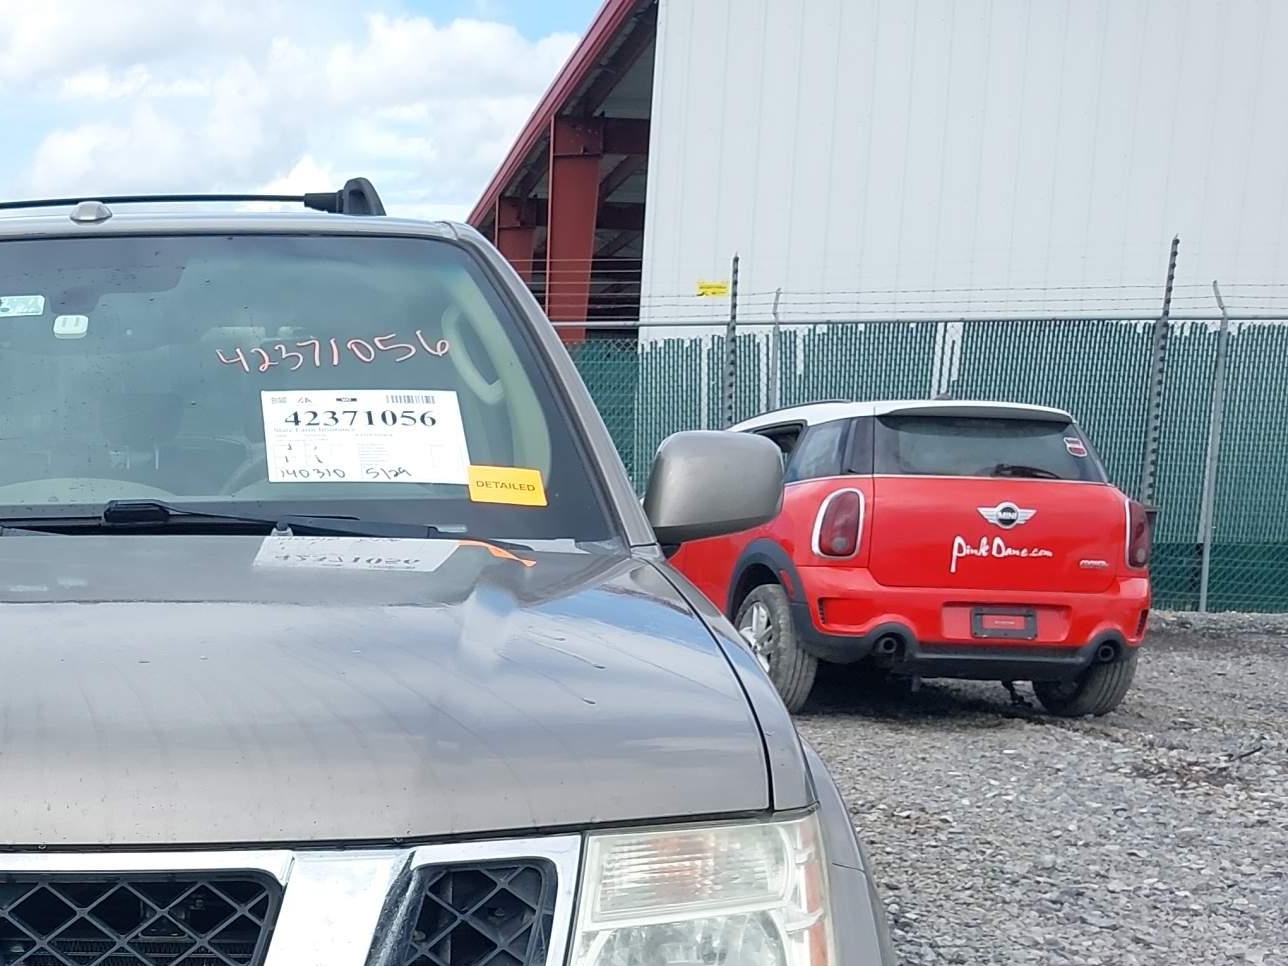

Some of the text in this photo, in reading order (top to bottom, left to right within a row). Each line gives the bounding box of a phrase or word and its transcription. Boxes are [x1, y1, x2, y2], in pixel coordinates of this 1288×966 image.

[216, 329, 450, 373] 42371056
[285, 409, 438, 428] 42371056
[475, 480, 536, 493] DETAILED
[998, 511, 1017, 520] MINI
